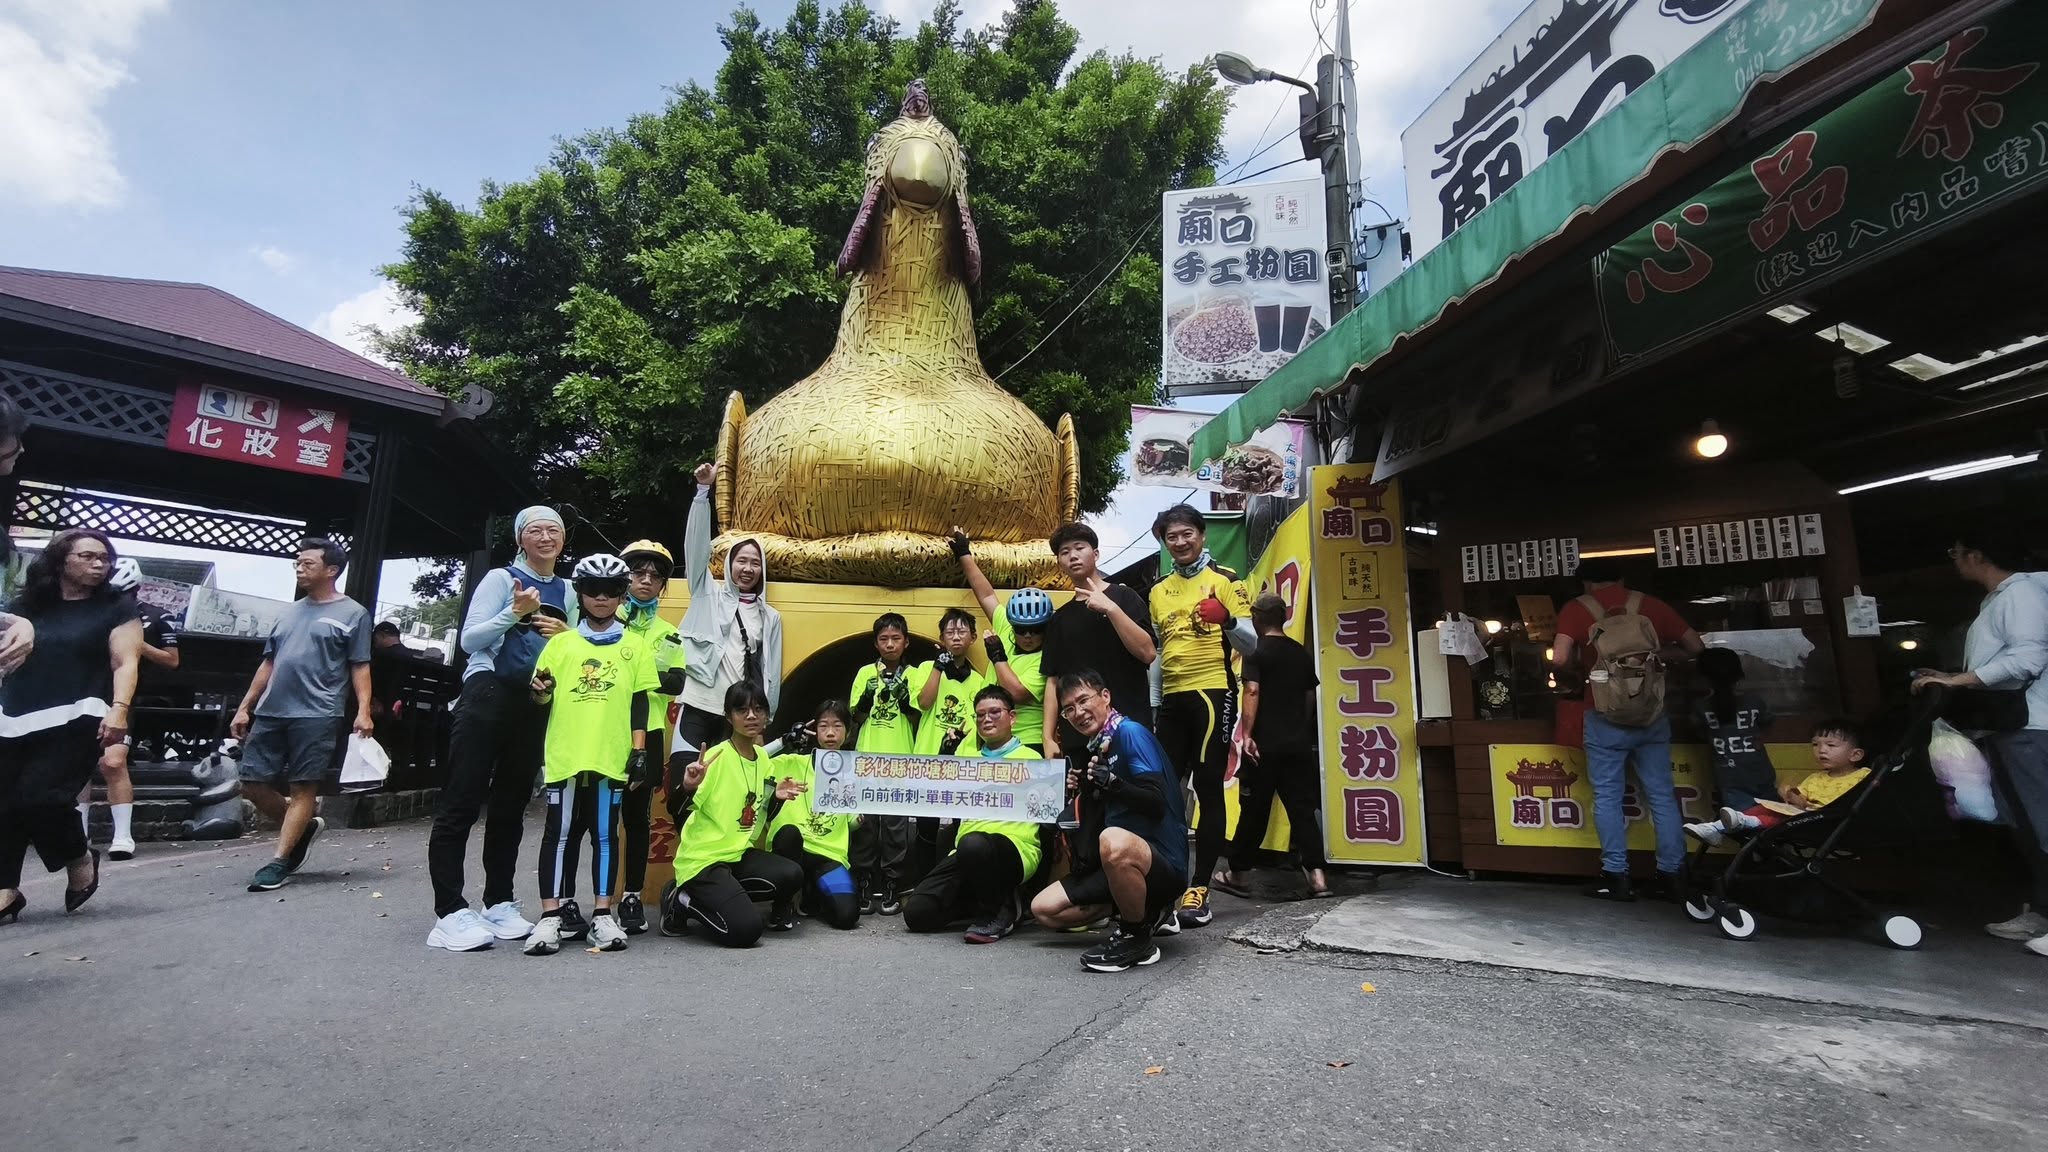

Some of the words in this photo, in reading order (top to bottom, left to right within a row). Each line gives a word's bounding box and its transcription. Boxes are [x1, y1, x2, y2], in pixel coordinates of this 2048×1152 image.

[1274, 195, 1286, 221] 古早味
[1177, 209, 1254, 245] 廟口
[1172, 248, 1320, 286] 手工粉圓
[185, 417, 331, 468] 化妝室
[1321, 506, 1393, 546] 廟口
[1348, 557, 1359, 587] 古早味
[1361, 563, 1373, 593] 純天然
[1222, 690, 1233, 743] GARMIN
[1332, 607, 1404, 844] 手工粉圓
[854, 756, 1030, 783] 彰化縣竹塘鄉土庫國小
[861, 787, 1014, 808] 向前衝刺-單車天使社團
[1510, 795, 1583, 829] 廟口
